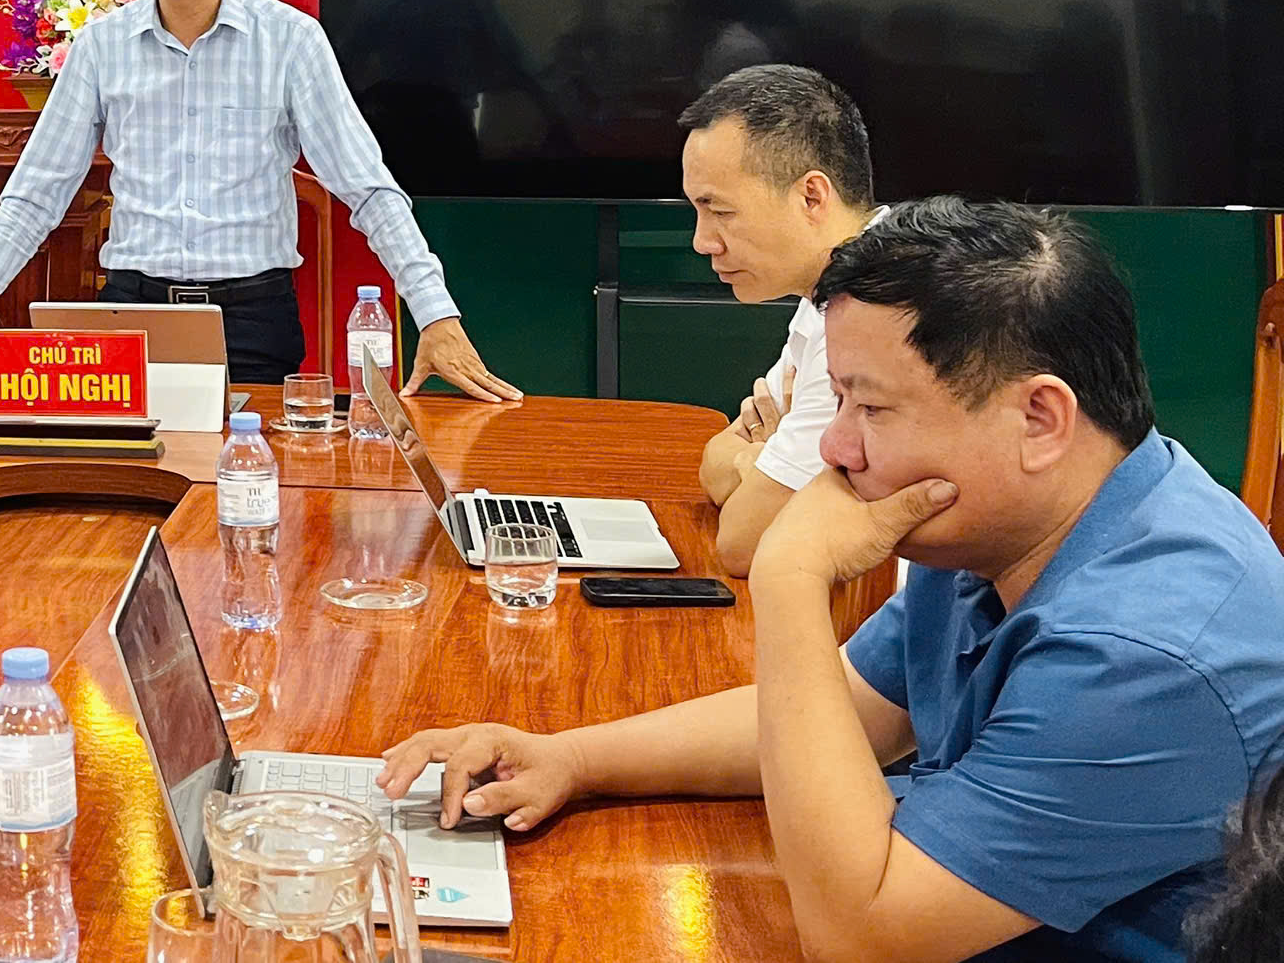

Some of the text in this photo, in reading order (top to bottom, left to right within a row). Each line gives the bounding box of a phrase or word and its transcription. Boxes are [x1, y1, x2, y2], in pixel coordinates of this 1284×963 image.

[28, 341, 102, 365] CHỦ TRÌ
[0, 367, 131, 408] HỘI NGHỊ
